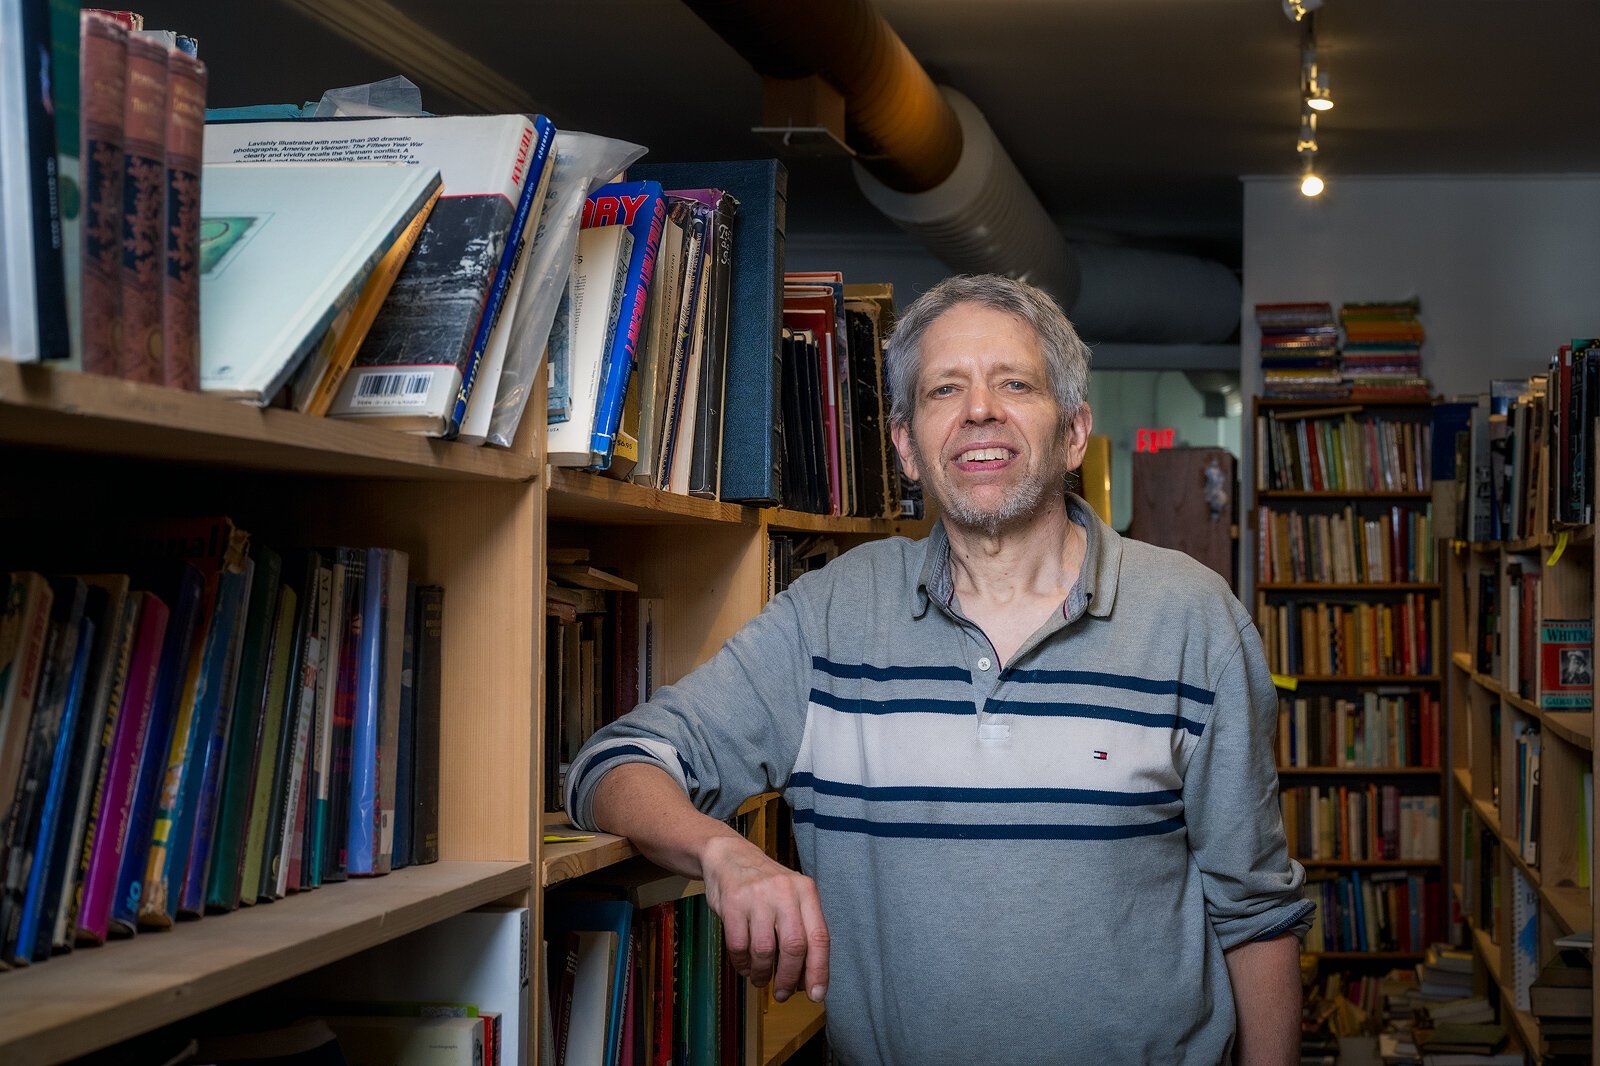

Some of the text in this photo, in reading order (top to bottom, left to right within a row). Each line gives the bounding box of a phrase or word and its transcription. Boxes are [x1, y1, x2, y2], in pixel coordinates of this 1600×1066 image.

[233, 146, 279, 154] photographs,
[283, 151, 306, 159] vividly
[511, 127, 534, 187] VIETNAM
[654, 197, 667, 215] US
[639, 216, 663, 287] MILITARY
[610, 257, 629, 315] Precious
[603, 312, 617, 365] Stones
[625, 284, 648, 361] AIRCRAFT
[1547, 628, 1591, 642] WHITM
[557, 994, 571, 1066] Acceptance
